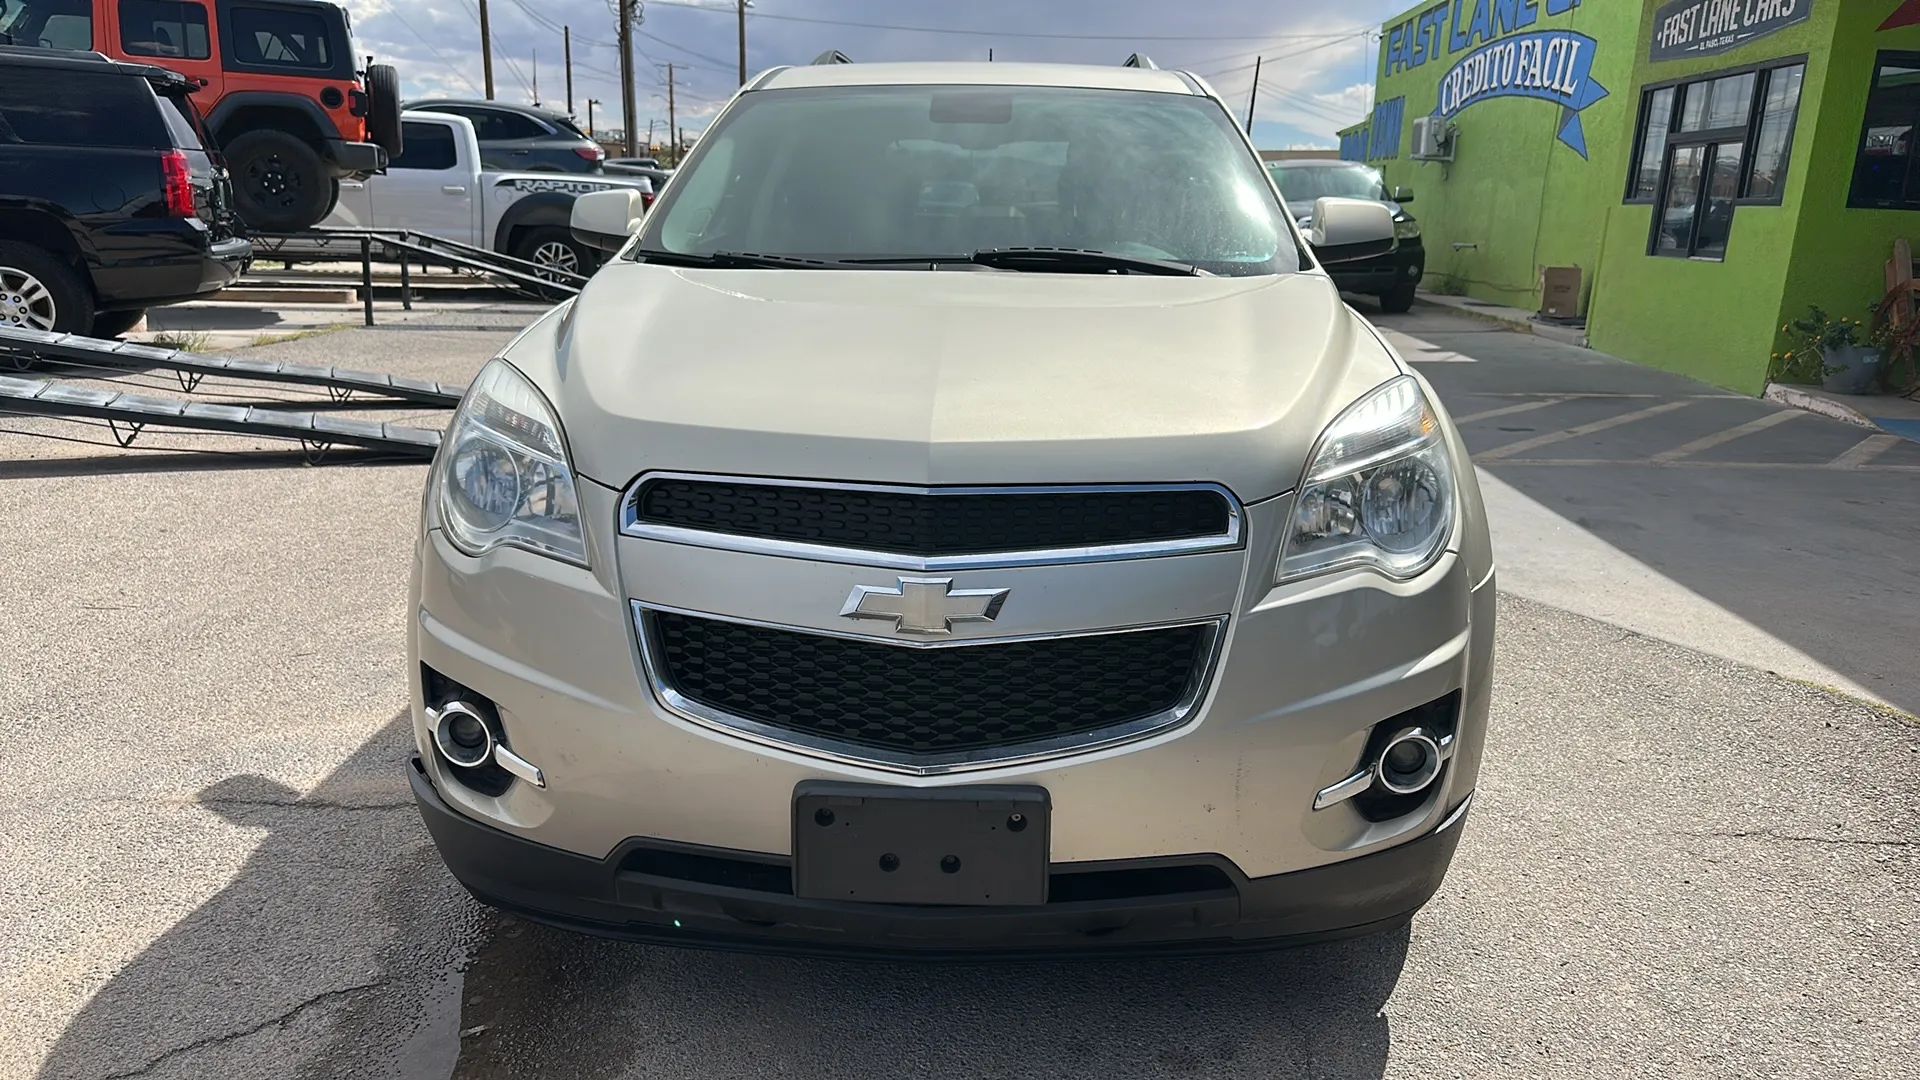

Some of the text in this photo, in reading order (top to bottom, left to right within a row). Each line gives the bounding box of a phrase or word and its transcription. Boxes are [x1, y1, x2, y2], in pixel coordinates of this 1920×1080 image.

[1384, 3, 1449, 77] FAST
[1661, 4, 1700, 49] FAST
[1699, 0, 1740, 39] LANE
[1441, 37, 1581, 116] CREDITO FACIL
[514, 179, 612, 193] RAPTOR
